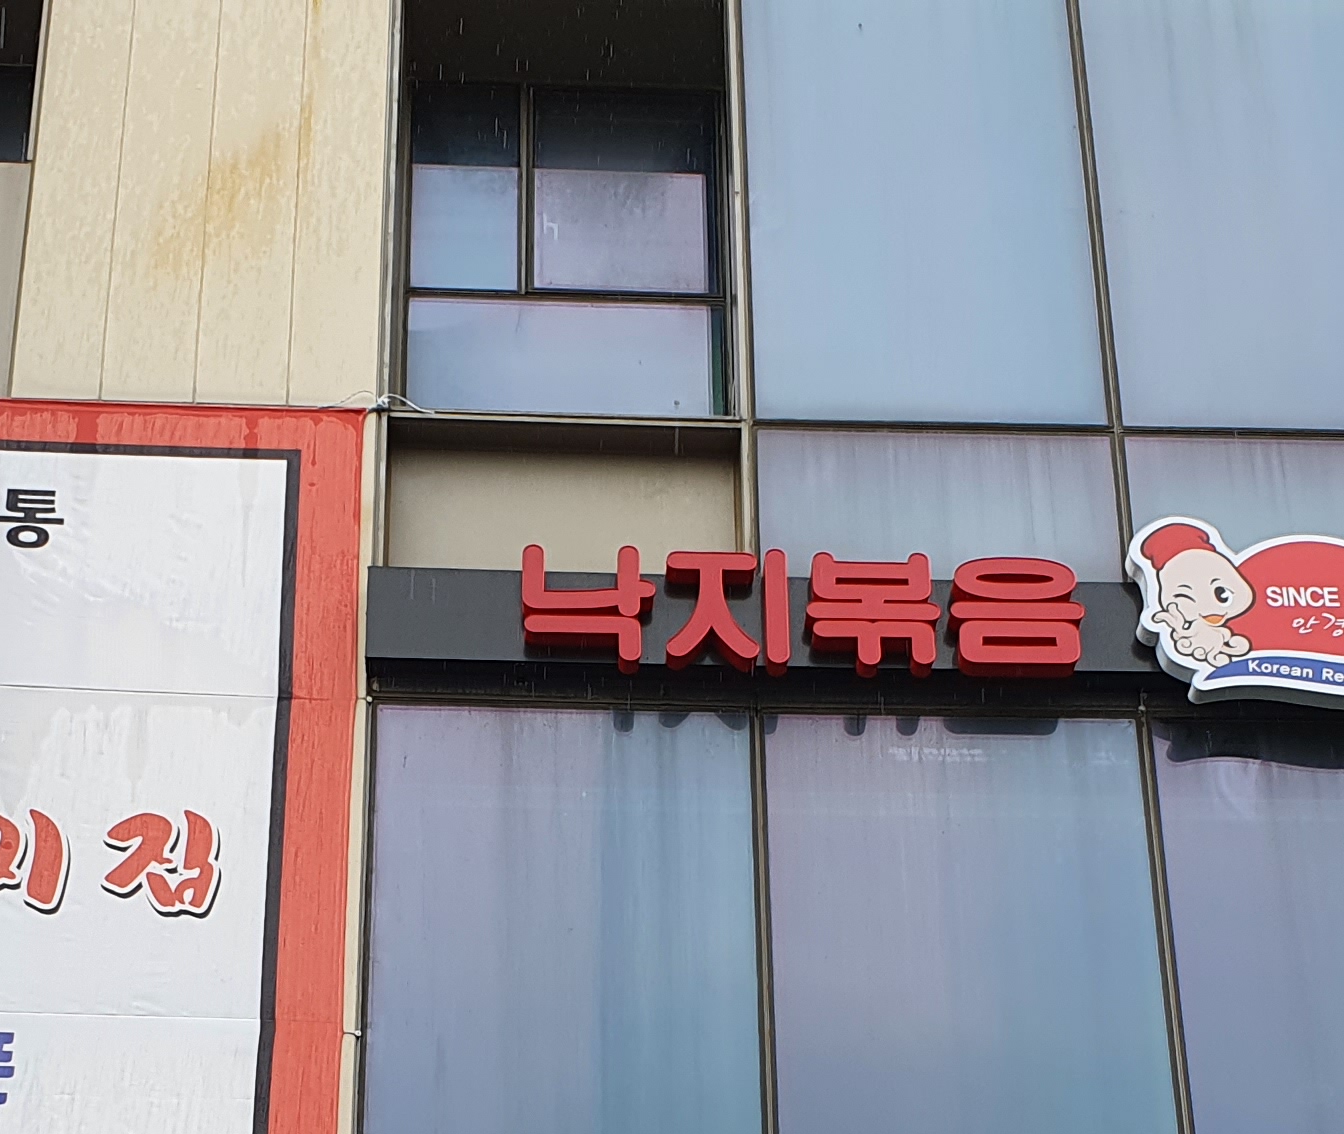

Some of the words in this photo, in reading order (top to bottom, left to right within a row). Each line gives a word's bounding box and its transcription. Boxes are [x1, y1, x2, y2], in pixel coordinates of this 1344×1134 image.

[1265, 586, 1340, 608] SINCE
[520, 543, 1085, 674] 낙지볶음
[1247, 659, 1313, 680] Korean
